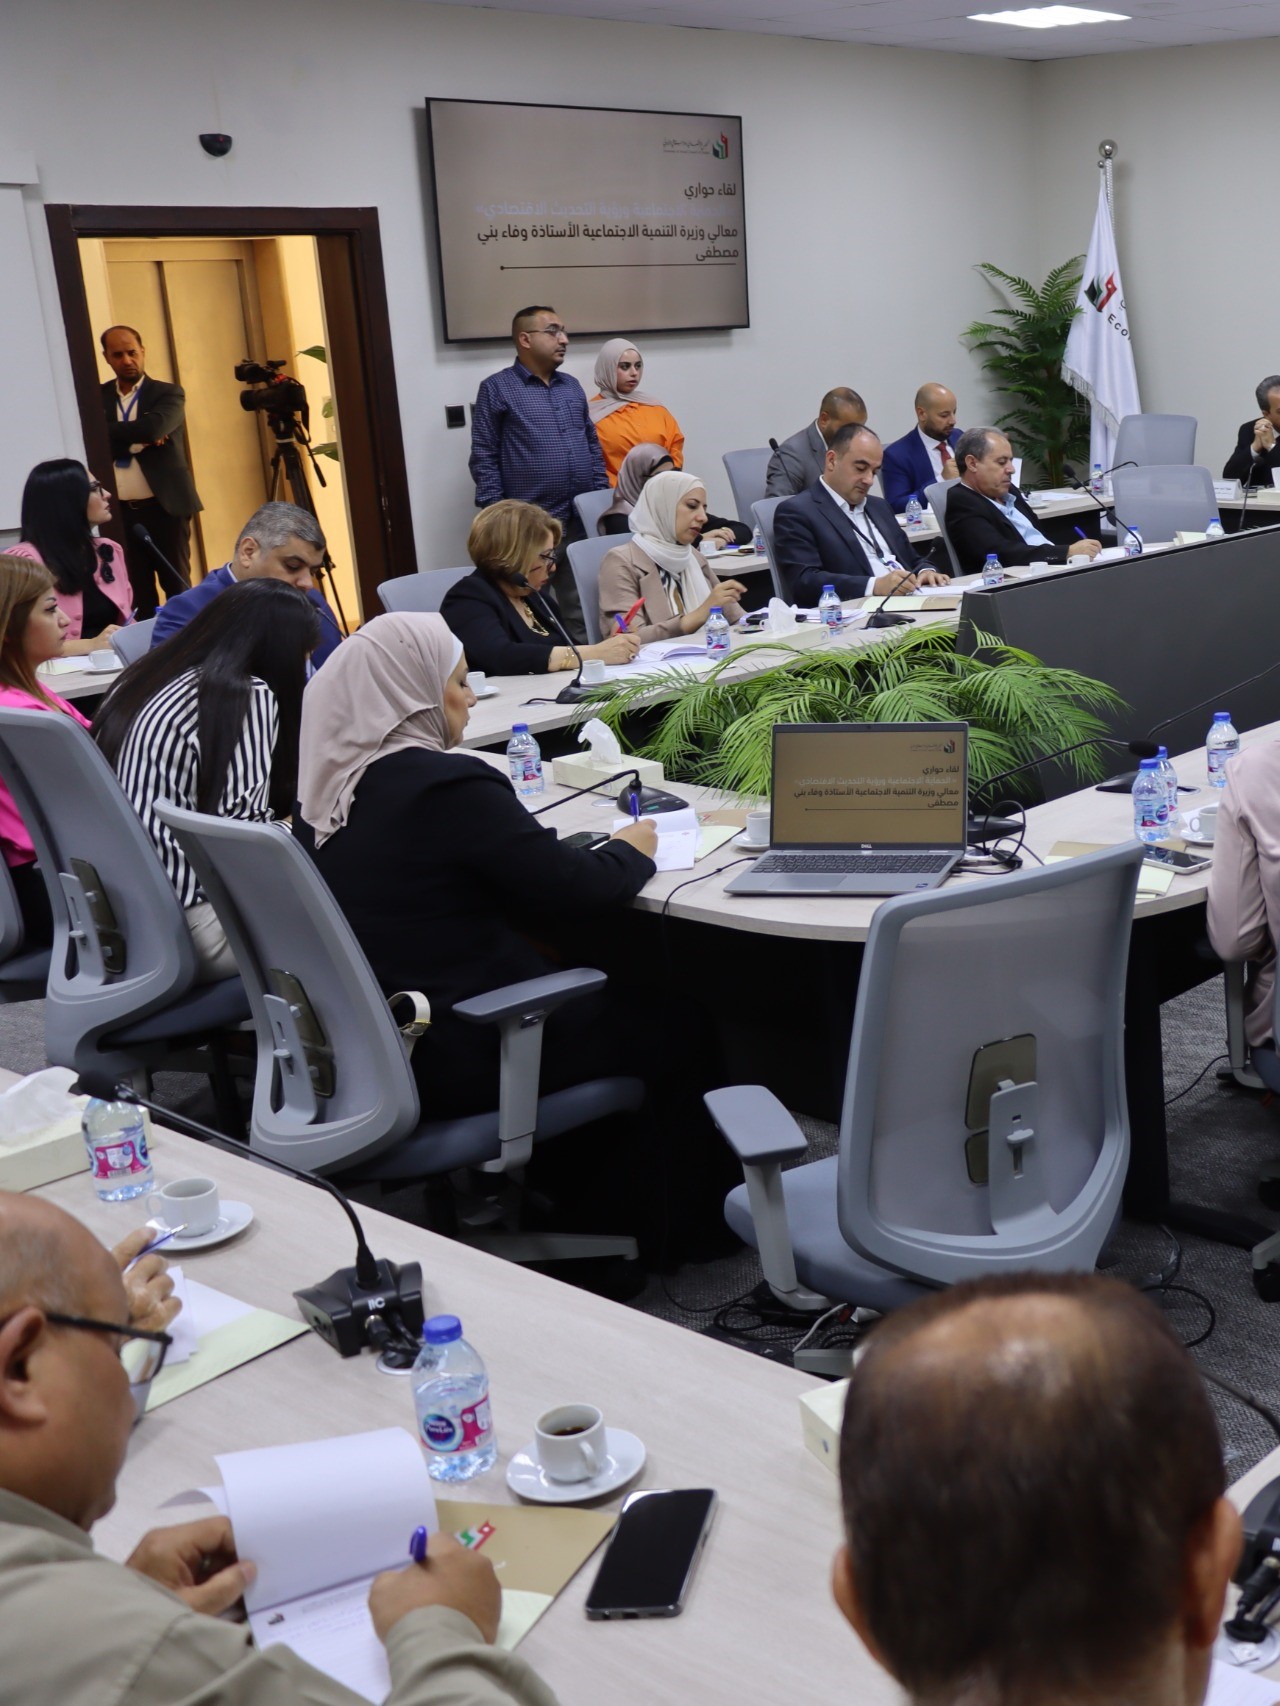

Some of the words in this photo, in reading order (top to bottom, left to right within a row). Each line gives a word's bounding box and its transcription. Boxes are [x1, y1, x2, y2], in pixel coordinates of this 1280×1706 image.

[684, 182, 715, 200] حواري
[717, 182, 736, 196] لقاء
[477, 224, 498, 246] بني
[501, 223, 528, 242] وفاء
[531, 221, 580, 238] الأستاذة
[582, 223, 639, 242] الاجتماعية
[641, 224, 677, 241] التنمية
[679, 225, 705, 241] وزيرة
[707, 224, 738, 244] معالي
[695, 245, 739, 262] مصطفى
[854, 787, 891, 797] الاجتماعية
[892, 787, 917, 797] التنمية
